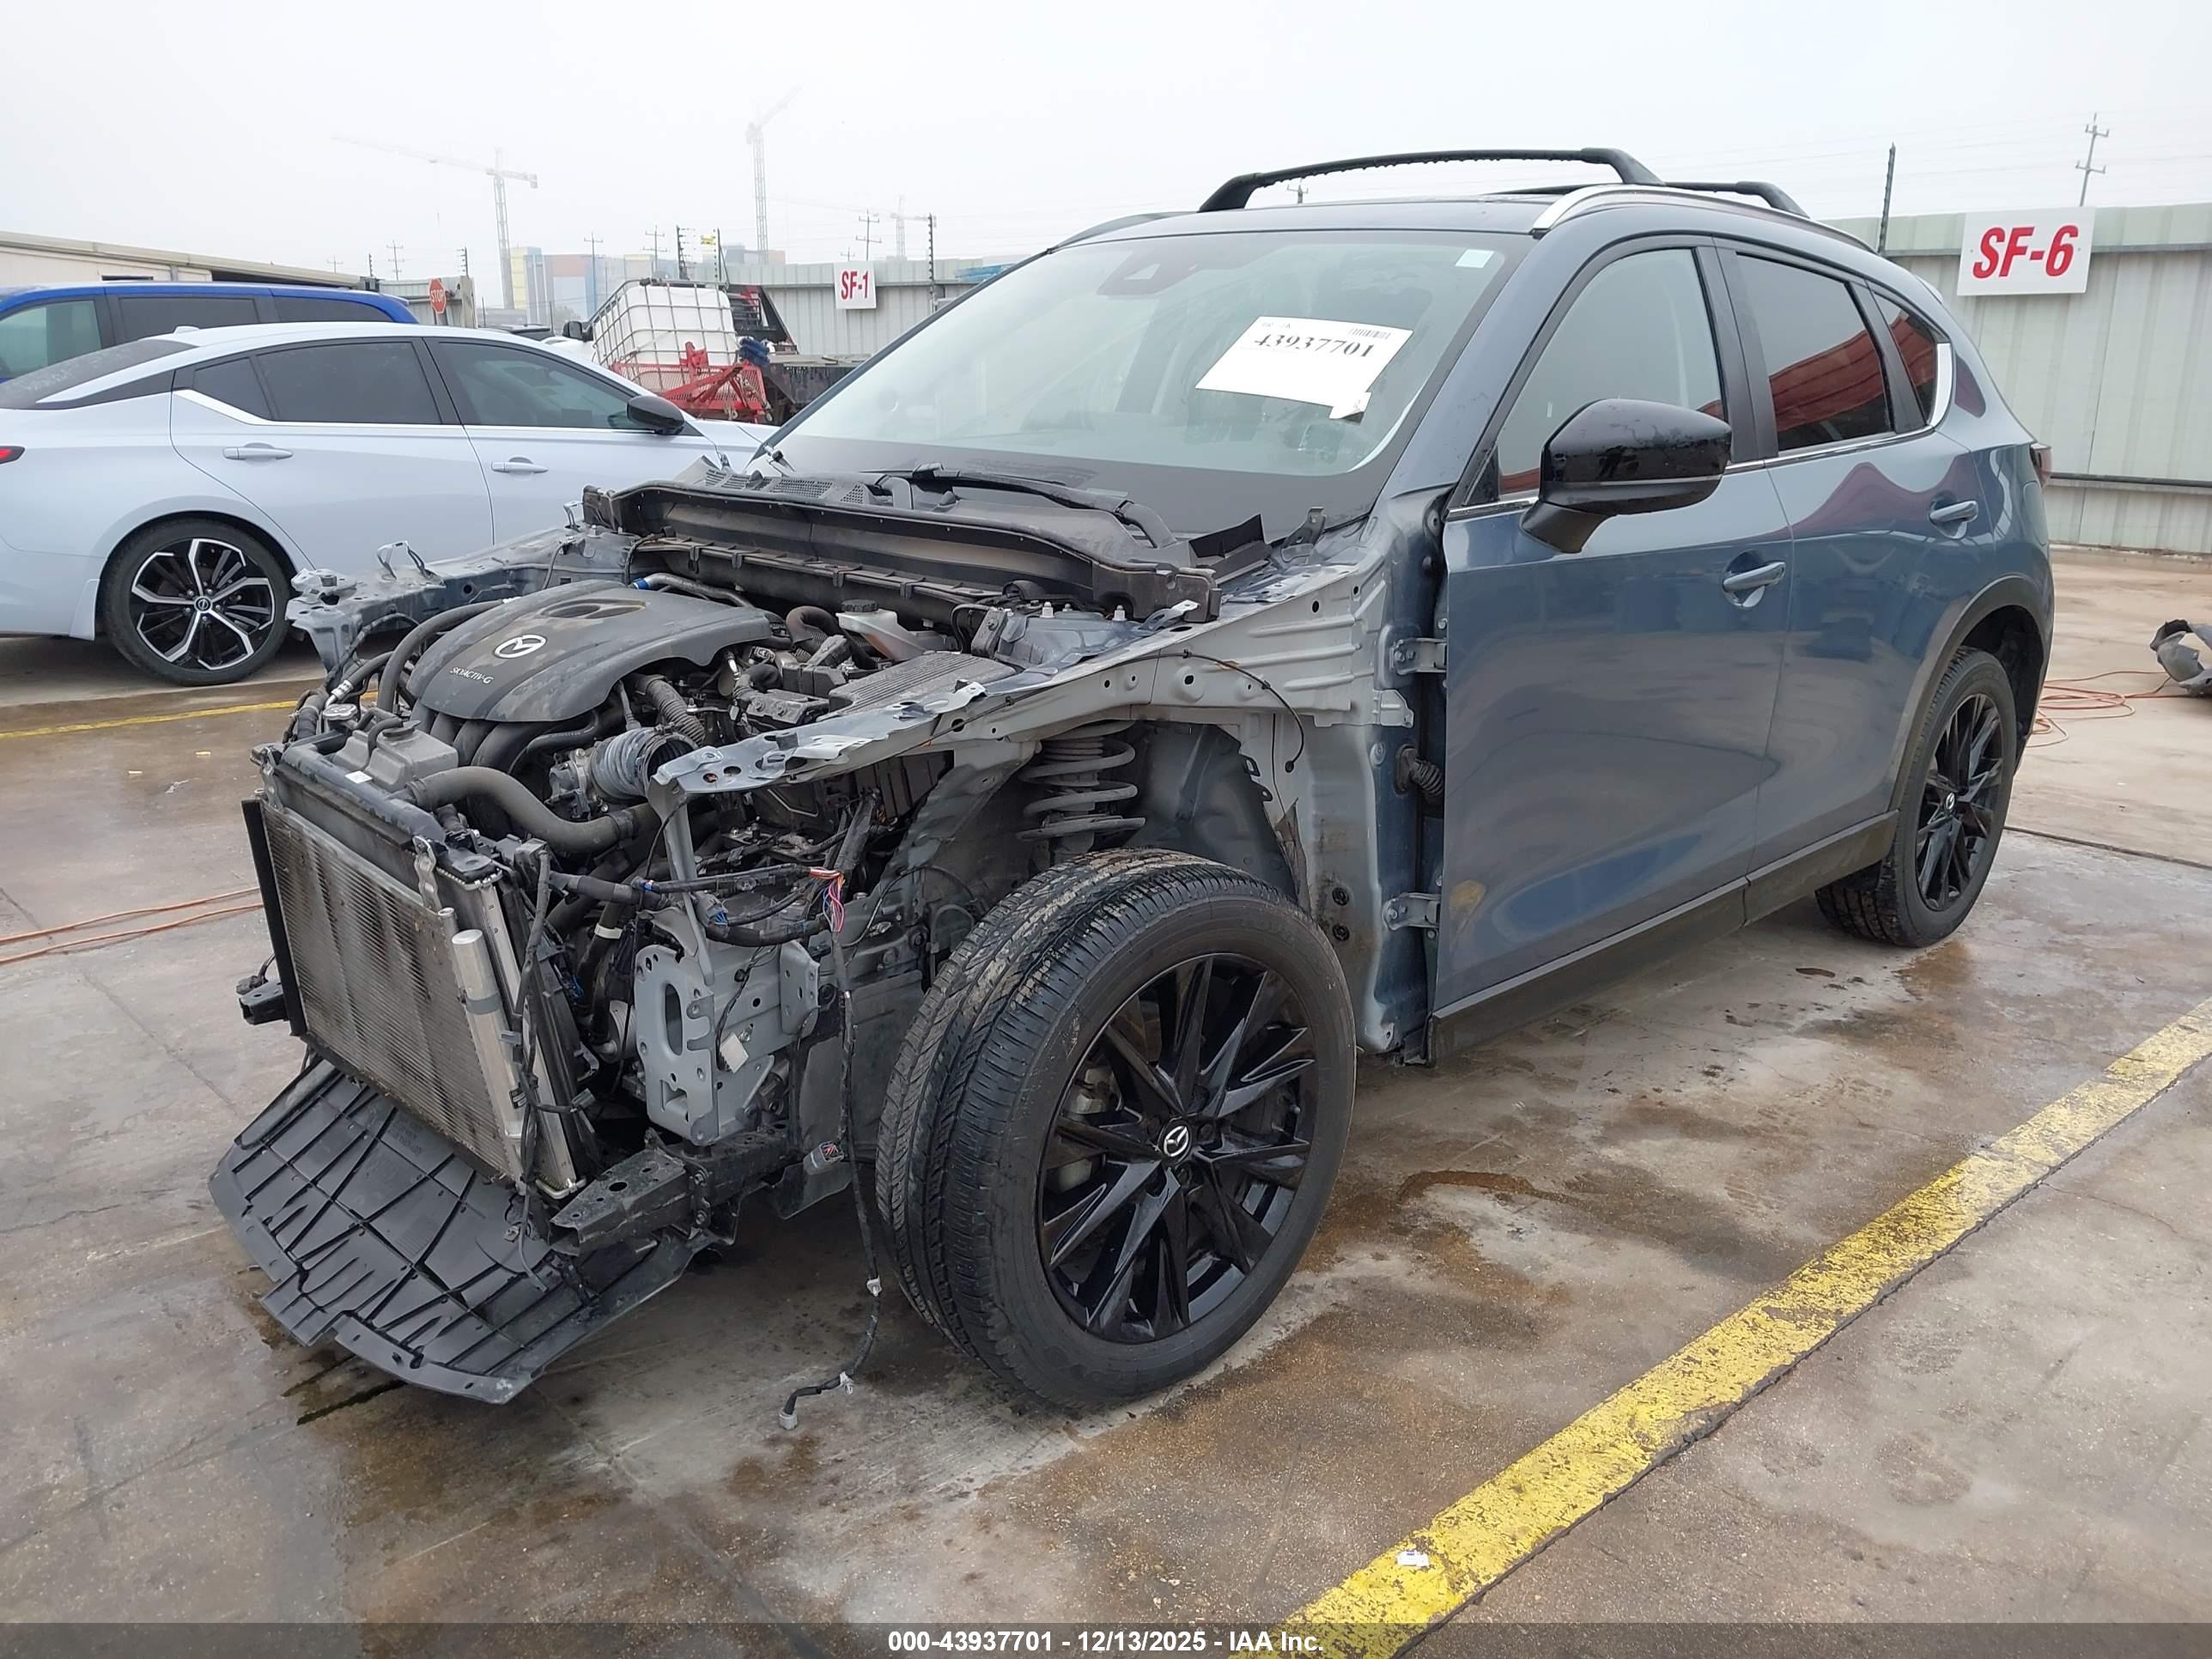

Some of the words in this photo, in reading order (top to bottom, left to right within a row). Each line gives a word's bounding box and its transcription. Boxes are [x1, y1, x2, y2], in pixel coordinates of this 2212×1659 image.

[1972, 224, 2079, 279] SF-6
[430, 289, 444, 303] STOP
[841, 270, 869, 300] SF-1
[1254, 333, 1375, 358] 43937701
